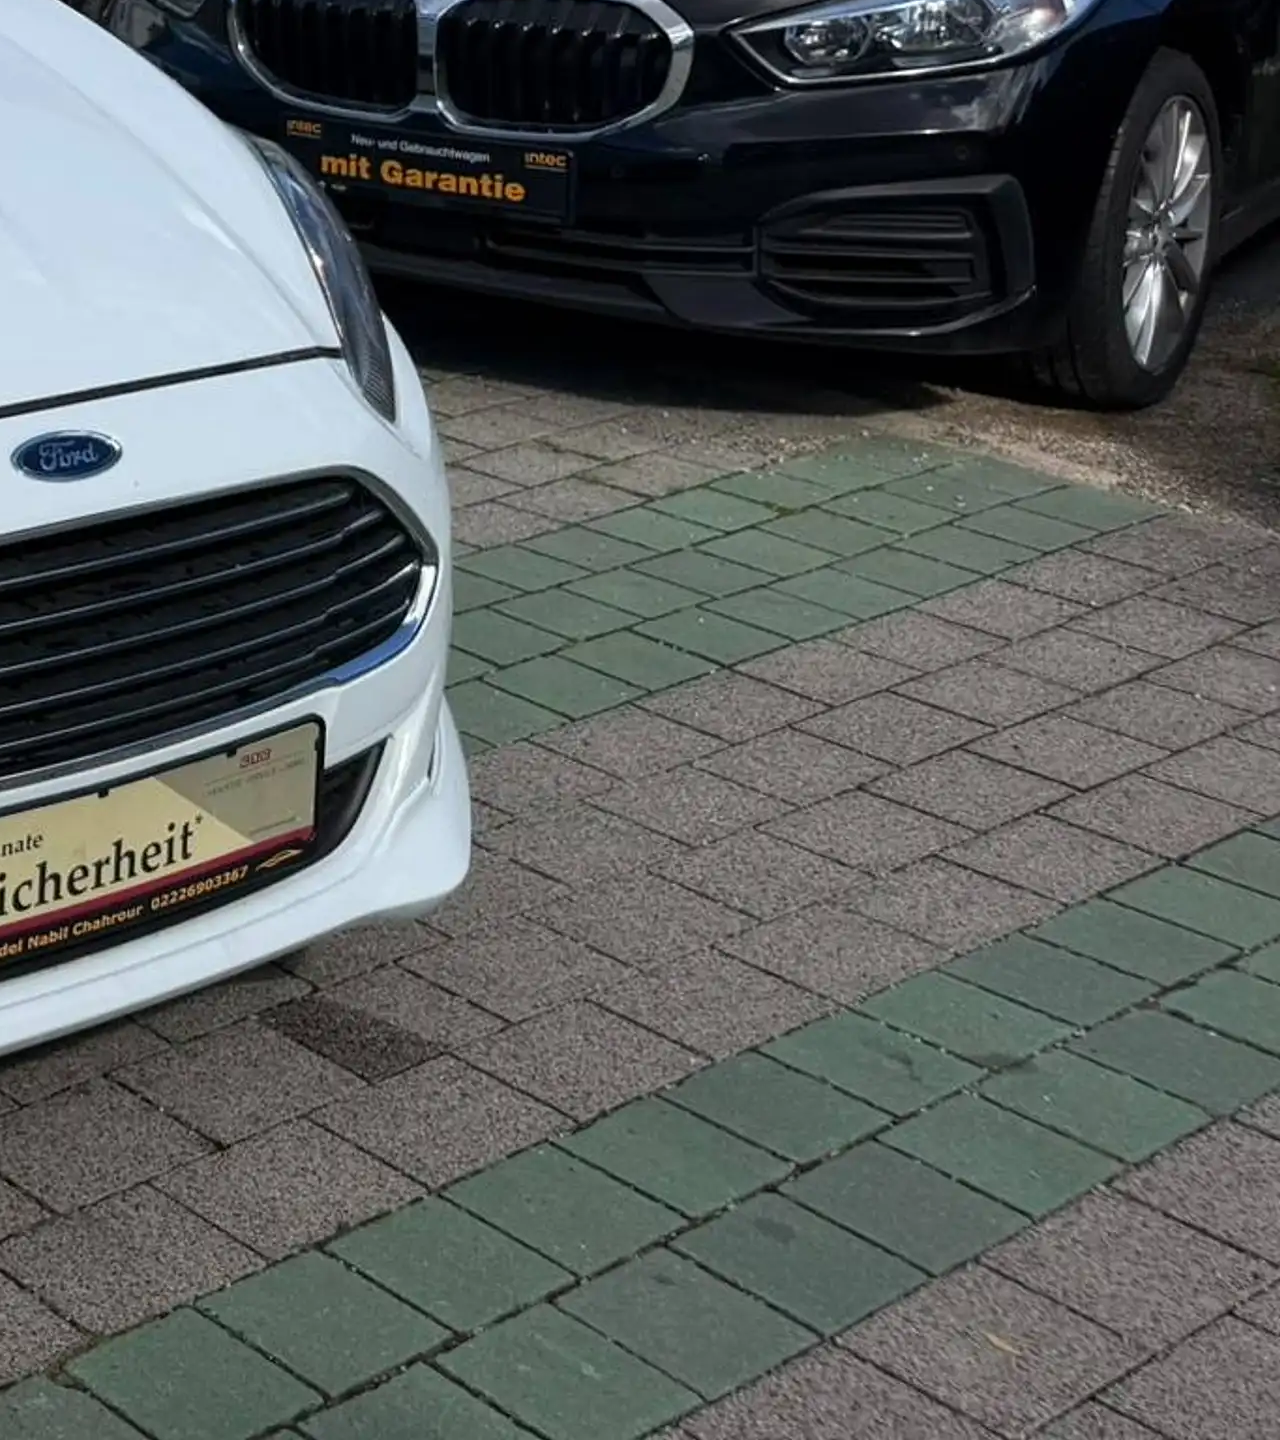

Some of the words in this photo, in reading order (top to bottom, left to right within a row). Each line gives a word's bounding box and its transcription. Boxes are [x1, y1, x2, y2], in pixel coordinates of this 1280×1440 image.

[399, 140, 491, 164] Gebrauchtwagen
[320, 153, 371, 180] mit
[380, 159, 526, 202] Garantie
[39, 440, 99, 472] Ford
[27, 926, 70, 951] Nabil
[72, 904, 145, 937] Chahrour
